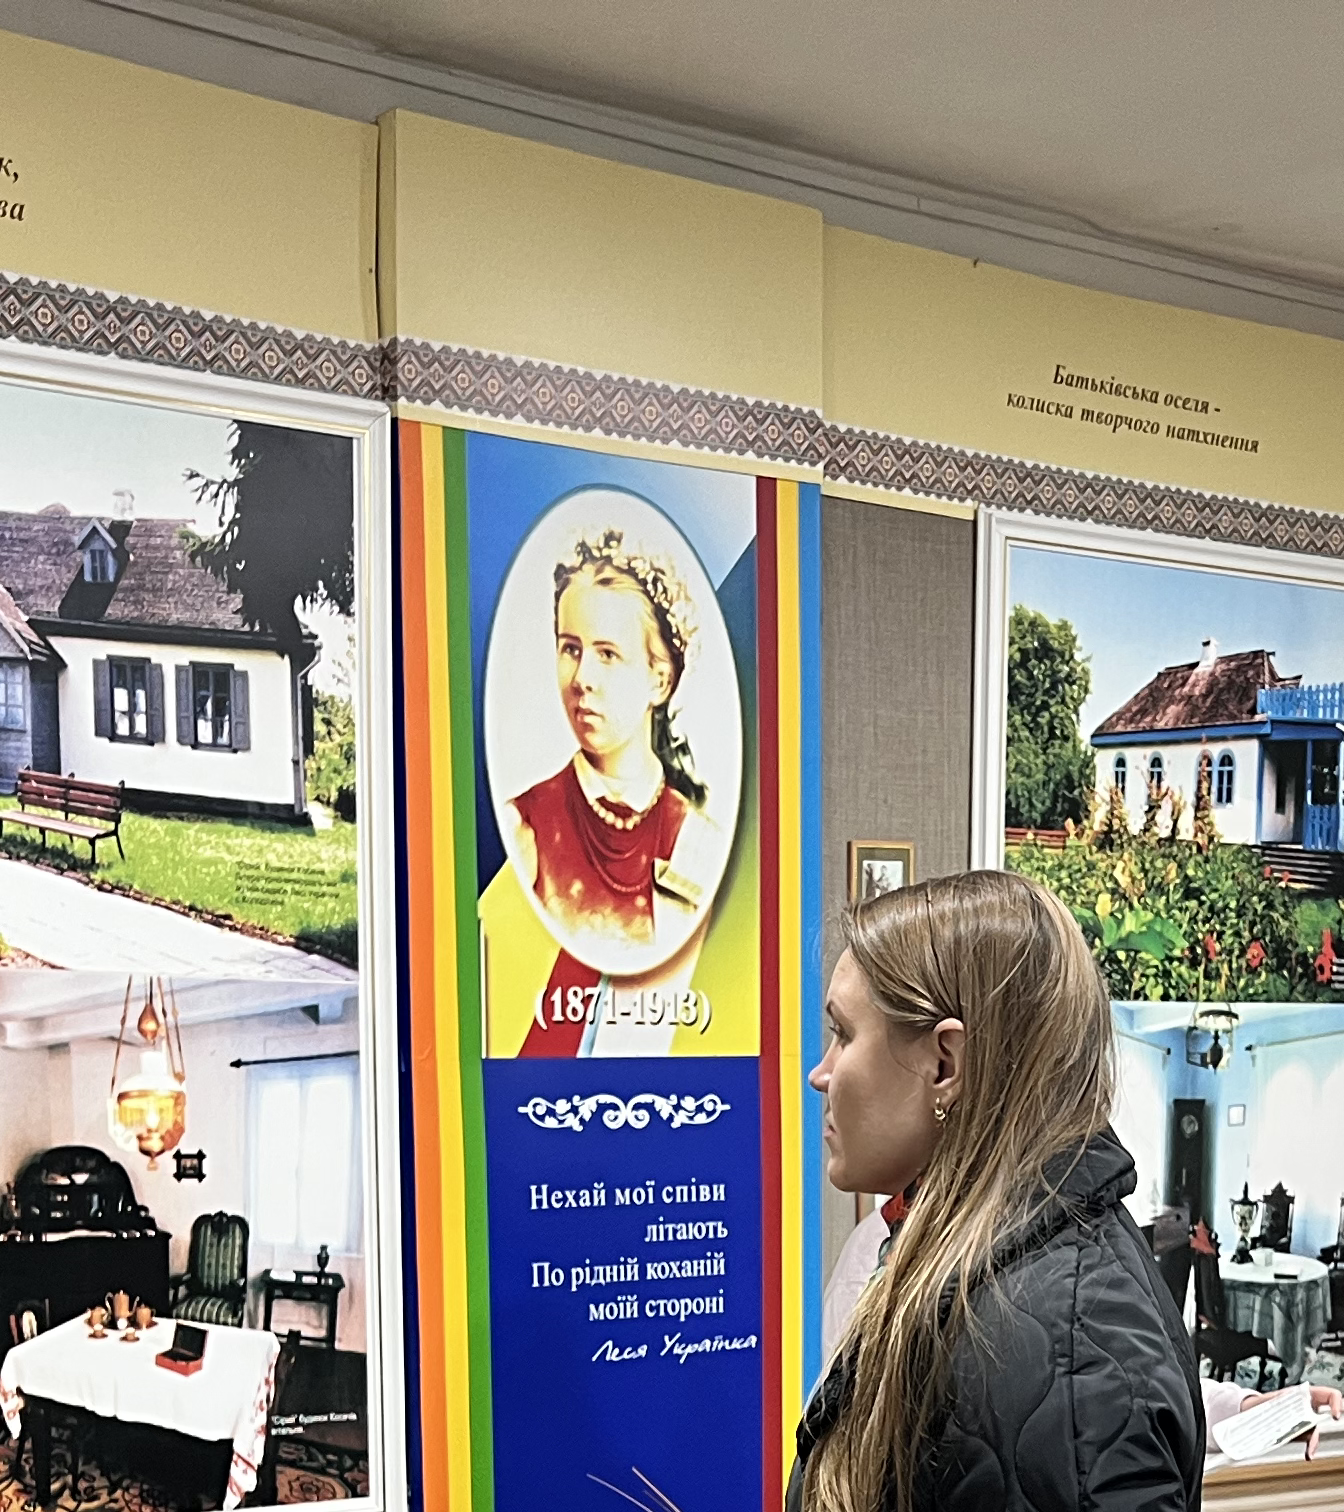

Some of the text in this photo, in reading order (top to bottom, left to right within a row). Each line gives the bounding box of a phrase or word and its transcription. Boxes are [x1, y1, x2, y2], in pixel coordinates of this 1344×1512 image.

[1053, 364, 1160, 405] Батьківська
[1163, 390, 1209, 415] оселя
[1007, 392, 1260, 454] колиска творчого натхнення
[533, 986, 712, 1034] (1871-1913)
[530, 1177, 726, 1211] Нехай мої співи
[645, 1216, 729, 1243] літають
[531, 1251, 726, 1292] По рідній коханій
[589, 1288, 725, 1322] моїй стороні
[591, 1331, 758, 1363] Леся Українка
